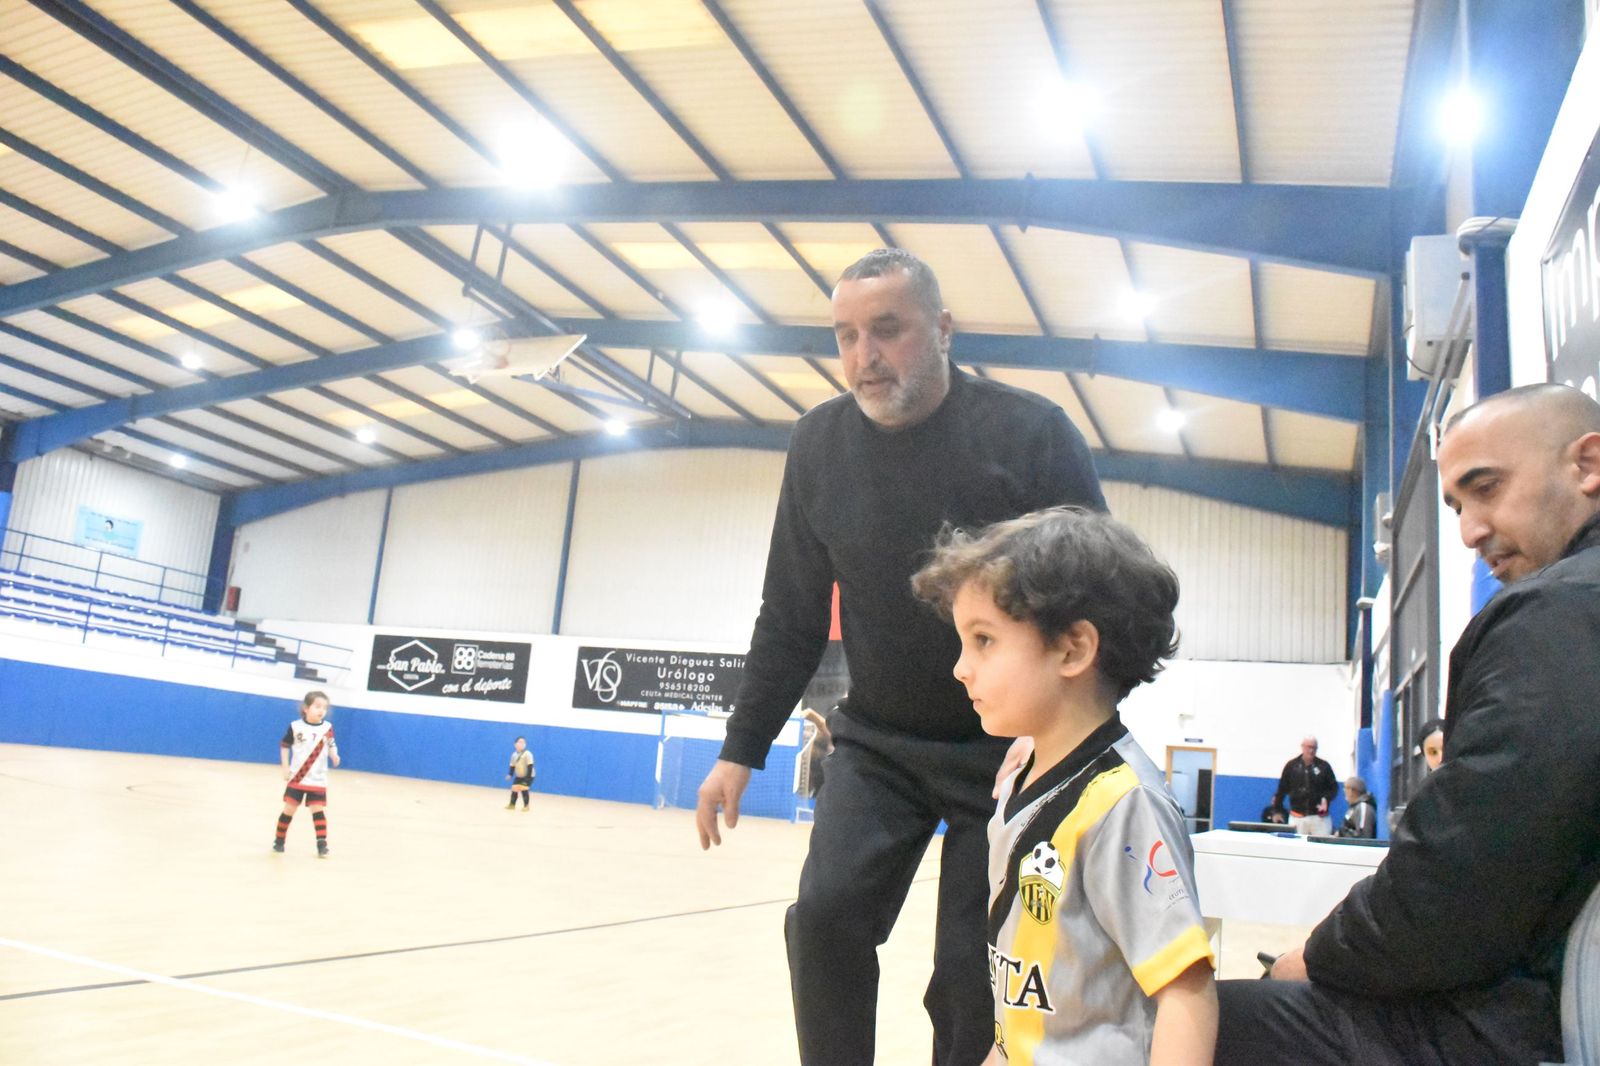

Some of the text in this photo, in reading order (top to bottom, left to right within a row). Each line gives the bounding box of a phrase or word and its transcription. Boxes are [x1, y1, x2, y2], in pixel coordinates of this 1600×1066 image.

[386, 655, 408, 672] San
[626, 653, 665, 664] Vicente
[670, 655, 714, 668] Dieguez
[657, 667, 715, 683] Urólogo
[442, 677, 512, 695] con el deporte
[664, 691, 693, 700] MEDICAL
[696, 693, 724, 701] CENTER
[691, 701, 724, 713] Adeslas
